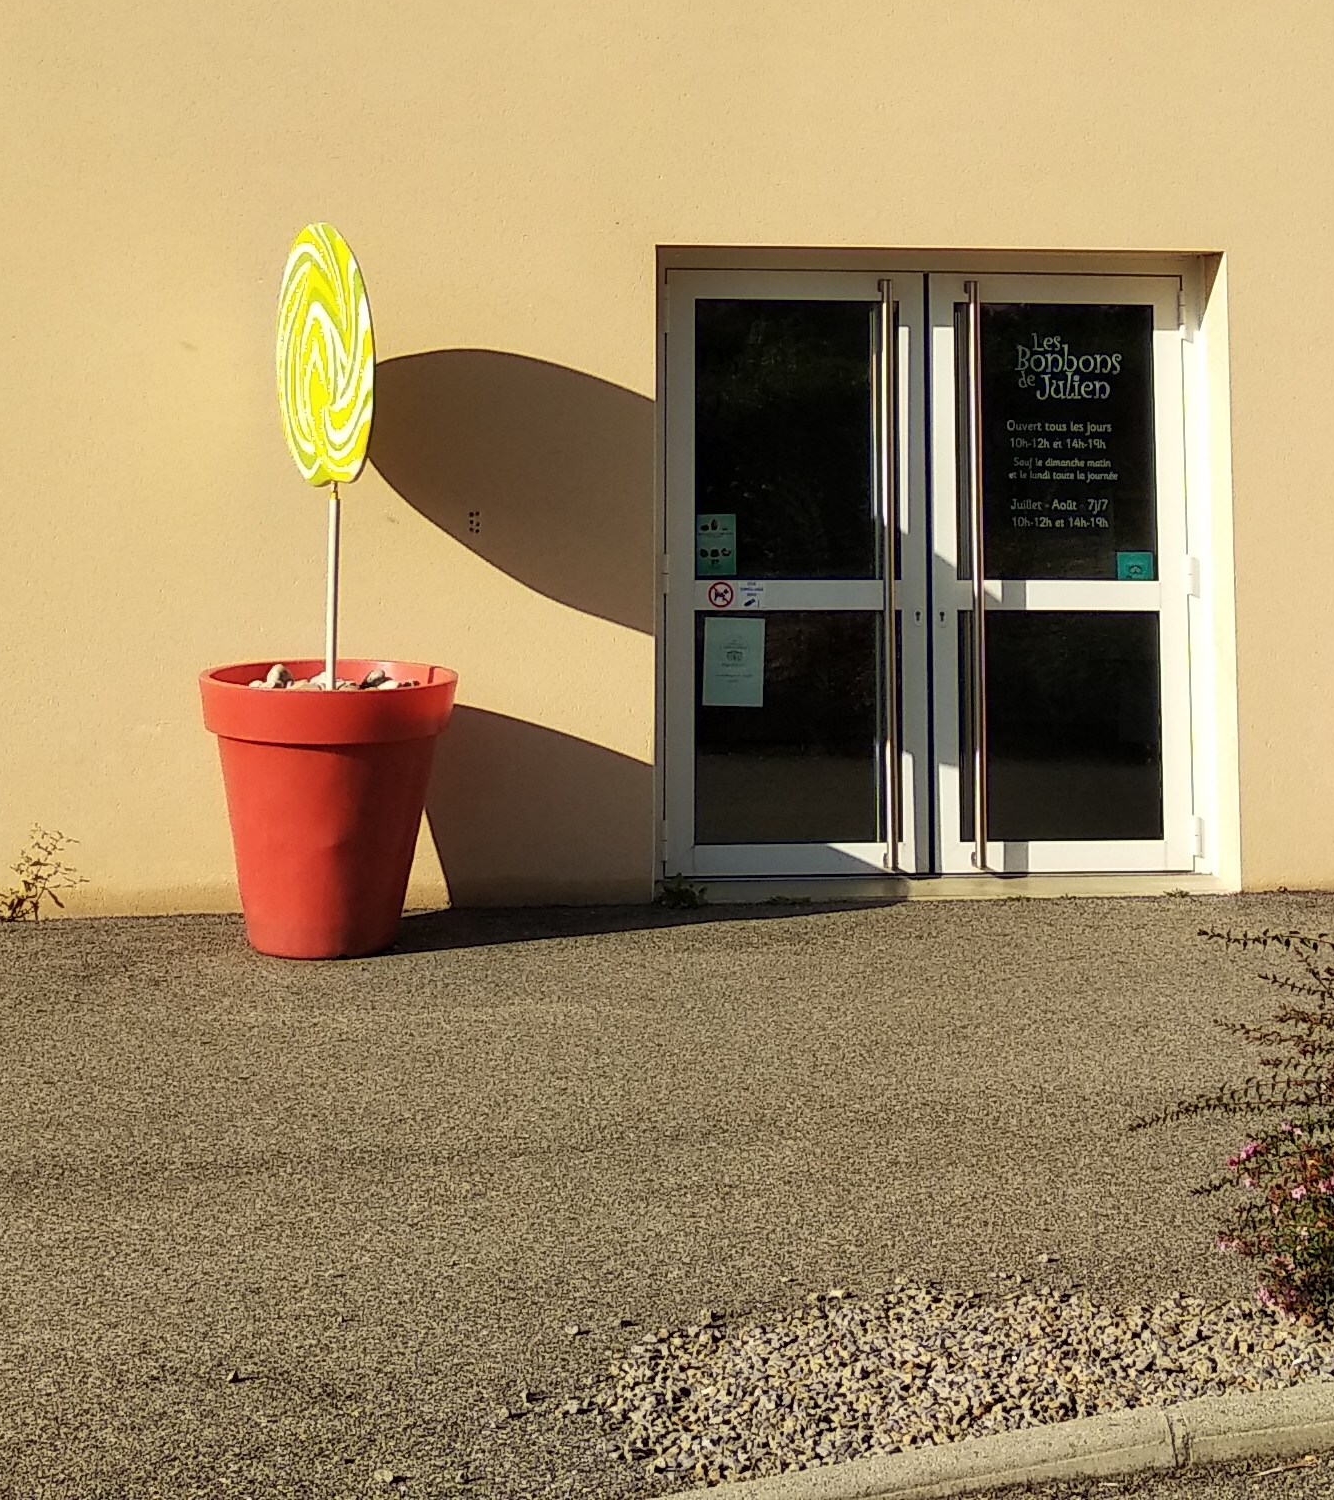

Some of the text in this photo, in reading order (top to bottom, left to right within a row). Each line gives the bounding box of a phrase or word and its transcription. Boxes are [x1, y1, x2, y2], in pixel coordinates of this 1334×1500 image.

[1031, 332, 1061, 351] Les
[1014, 343, 1123, 375] Bonbons
[1018, 370, 1036, 388] de
[1035, 371, 1111, 401] Julien
[1006, 419, 1112, 436] Ouvert tous les jours
[1009, 437, 1107, 449] 10h-12h et 14h-19h
[1013, 457, 1111, 469] Sauf le dimanche matin
[1008, 470, 1119, 483] et le lundi toute la journée
[1010, 498, 1043, 510] Juillet
[1051, 498, 1078, 510] Août
[1087, 498, 1109, 515] 7j/7
[1012, 516, 1110, 528] 10h-12h et 14h-19h
